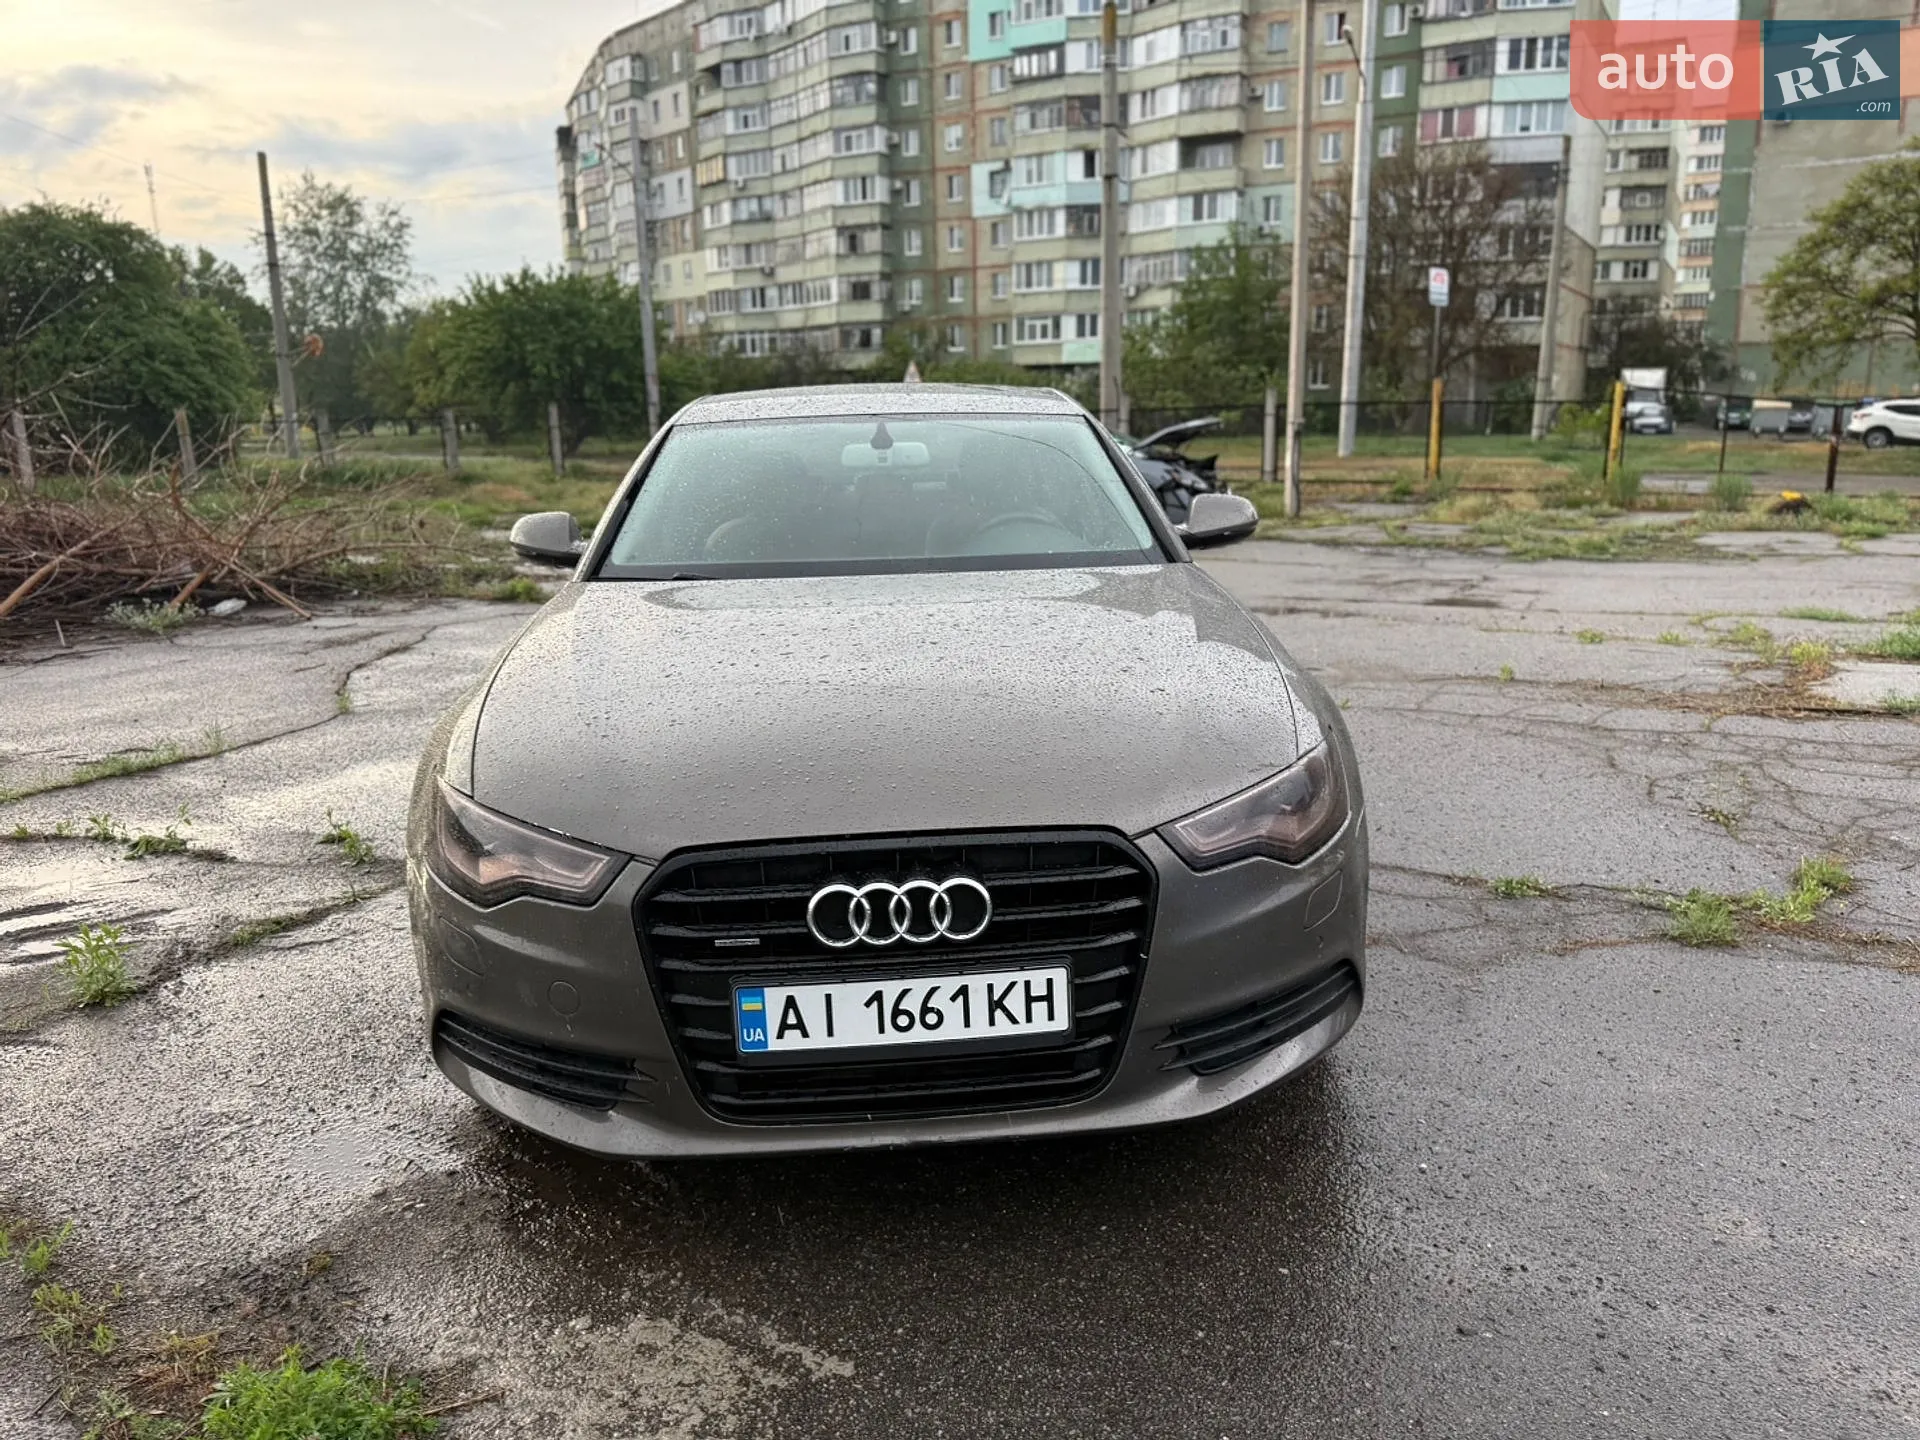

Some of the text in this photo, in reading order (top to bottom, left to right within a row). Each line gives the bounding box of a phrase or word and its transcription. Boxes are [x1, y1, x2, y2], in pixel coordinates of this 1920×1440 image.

[776, 977, 1055, 1040] AI 1661 KH
[743, 1028, 766, 1042] UA
